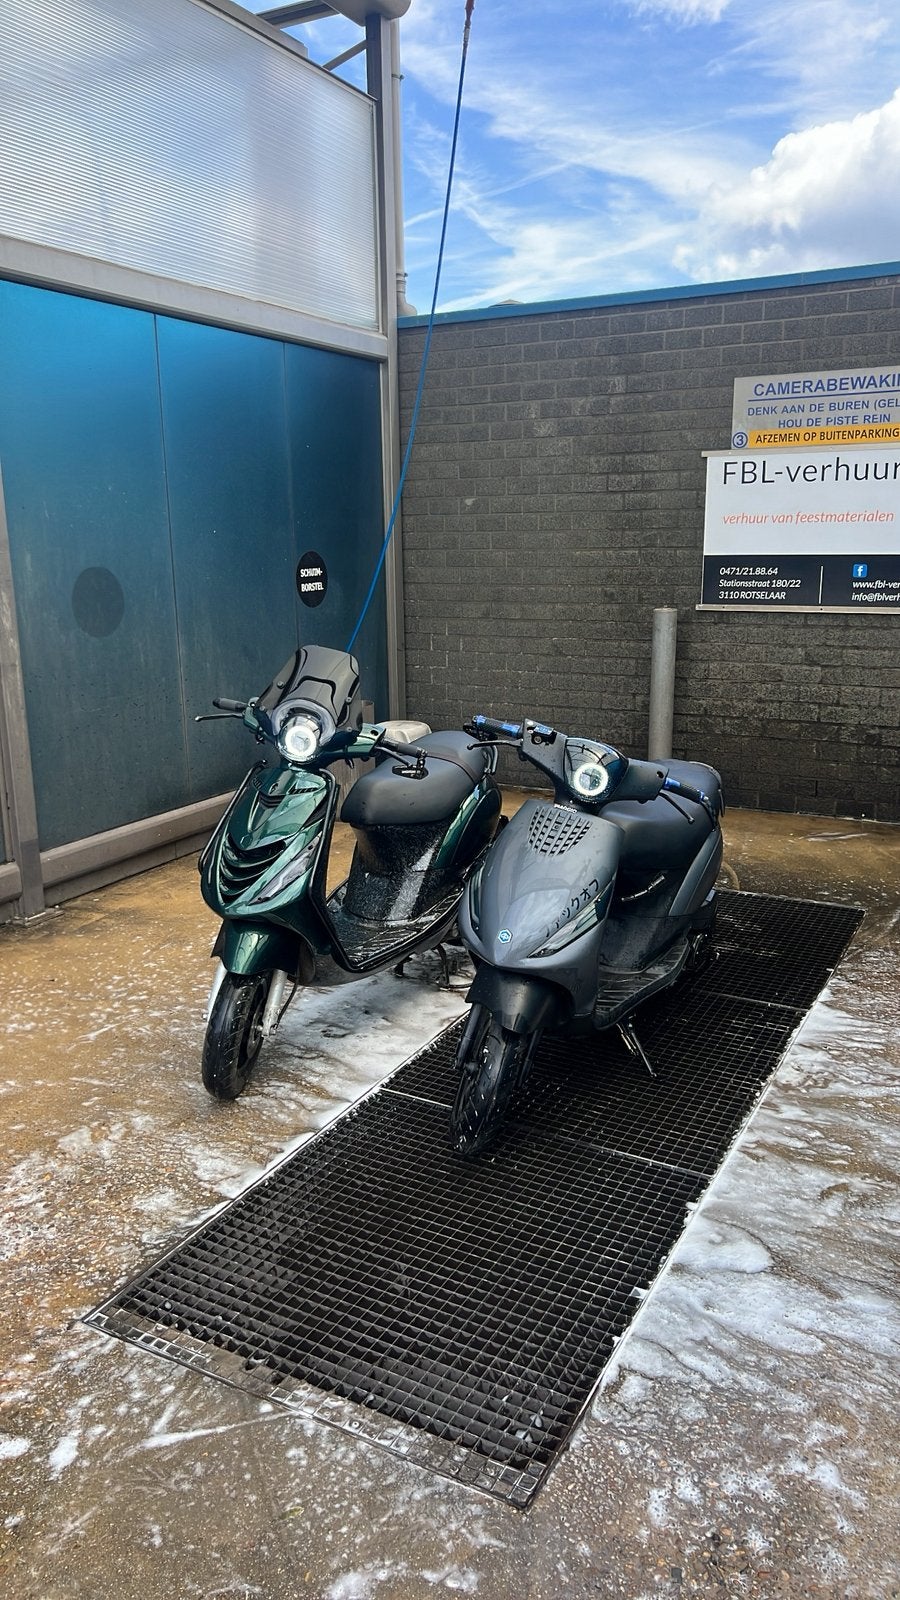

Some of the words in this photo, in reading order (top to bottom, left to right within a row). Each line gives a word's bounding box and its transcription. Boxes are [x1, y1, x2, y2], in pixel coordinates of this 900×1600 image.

[747, 405, 778, 416] DENK
[781, 404, 805, 415] AAN
[809, 402, 825, 413] DE
[828, 400, 870, 412] BUREN
[778, 418, 802, 429] HOU
[806, 417, 822, 427] DE
[825, 415, 859, 427] PISTE
[863, 413, 891, 424] REIN
[736, 434, 744, 446] 3
[755, 432, 800, 444] AFZEMEN
[803, 432, 817, 442] OP
[819, 427, 900, 442] BUITENPARKING
[723, 456, 900, 485] FBL-verhuur
[723, 512, 769, 524] verhuur
[771, 513, 793, 524] van
[795, 510, 894, 525] feestmaterialen
[719, 567, 778, 576] 0471/21.88.64
[301, 582, 324, 592] BORSTEL
[718, 579, 770, 588] Stationsstraat
[771, 579, 801, 588] 180/22
[718, 591, 739, 599] 3110
[740, 591, 787, 600] ROTSELAAR
